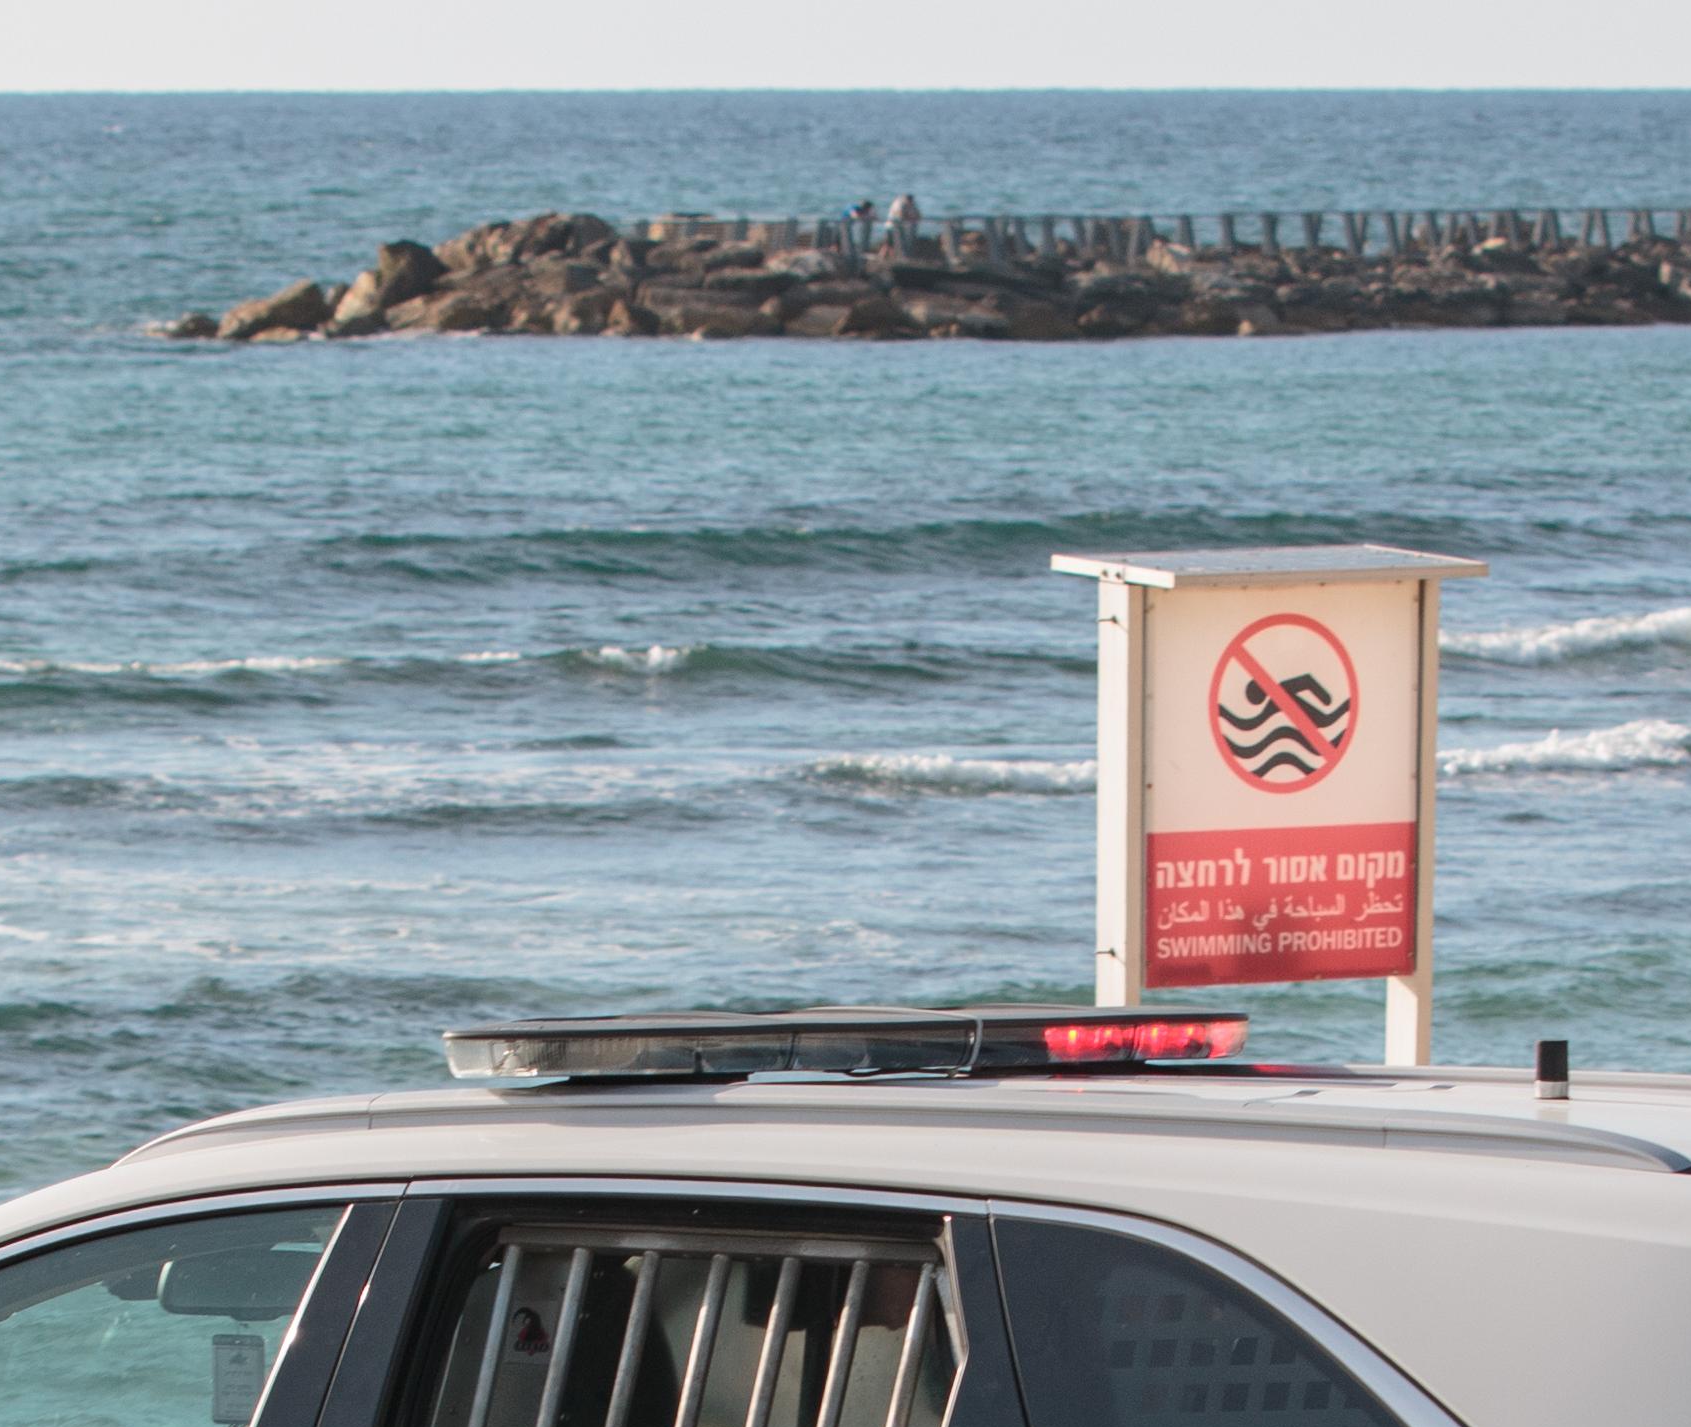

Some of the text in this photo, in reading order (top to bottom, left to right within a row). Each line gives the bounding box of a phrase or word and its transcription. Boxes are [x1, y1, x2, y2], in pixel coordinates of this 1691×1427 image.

[1156, 848, 1405, 888] מקום אסור לרחצה
[1157, 899, 1209, 929] المكان
[1217, 899, 1245, 920] هذا
[1253, 898, 1278, 930] في
[1284, 894, 1345, 921] السباحة
[1157, 927, 1403, 959] SWIMMING PROHIBITED
